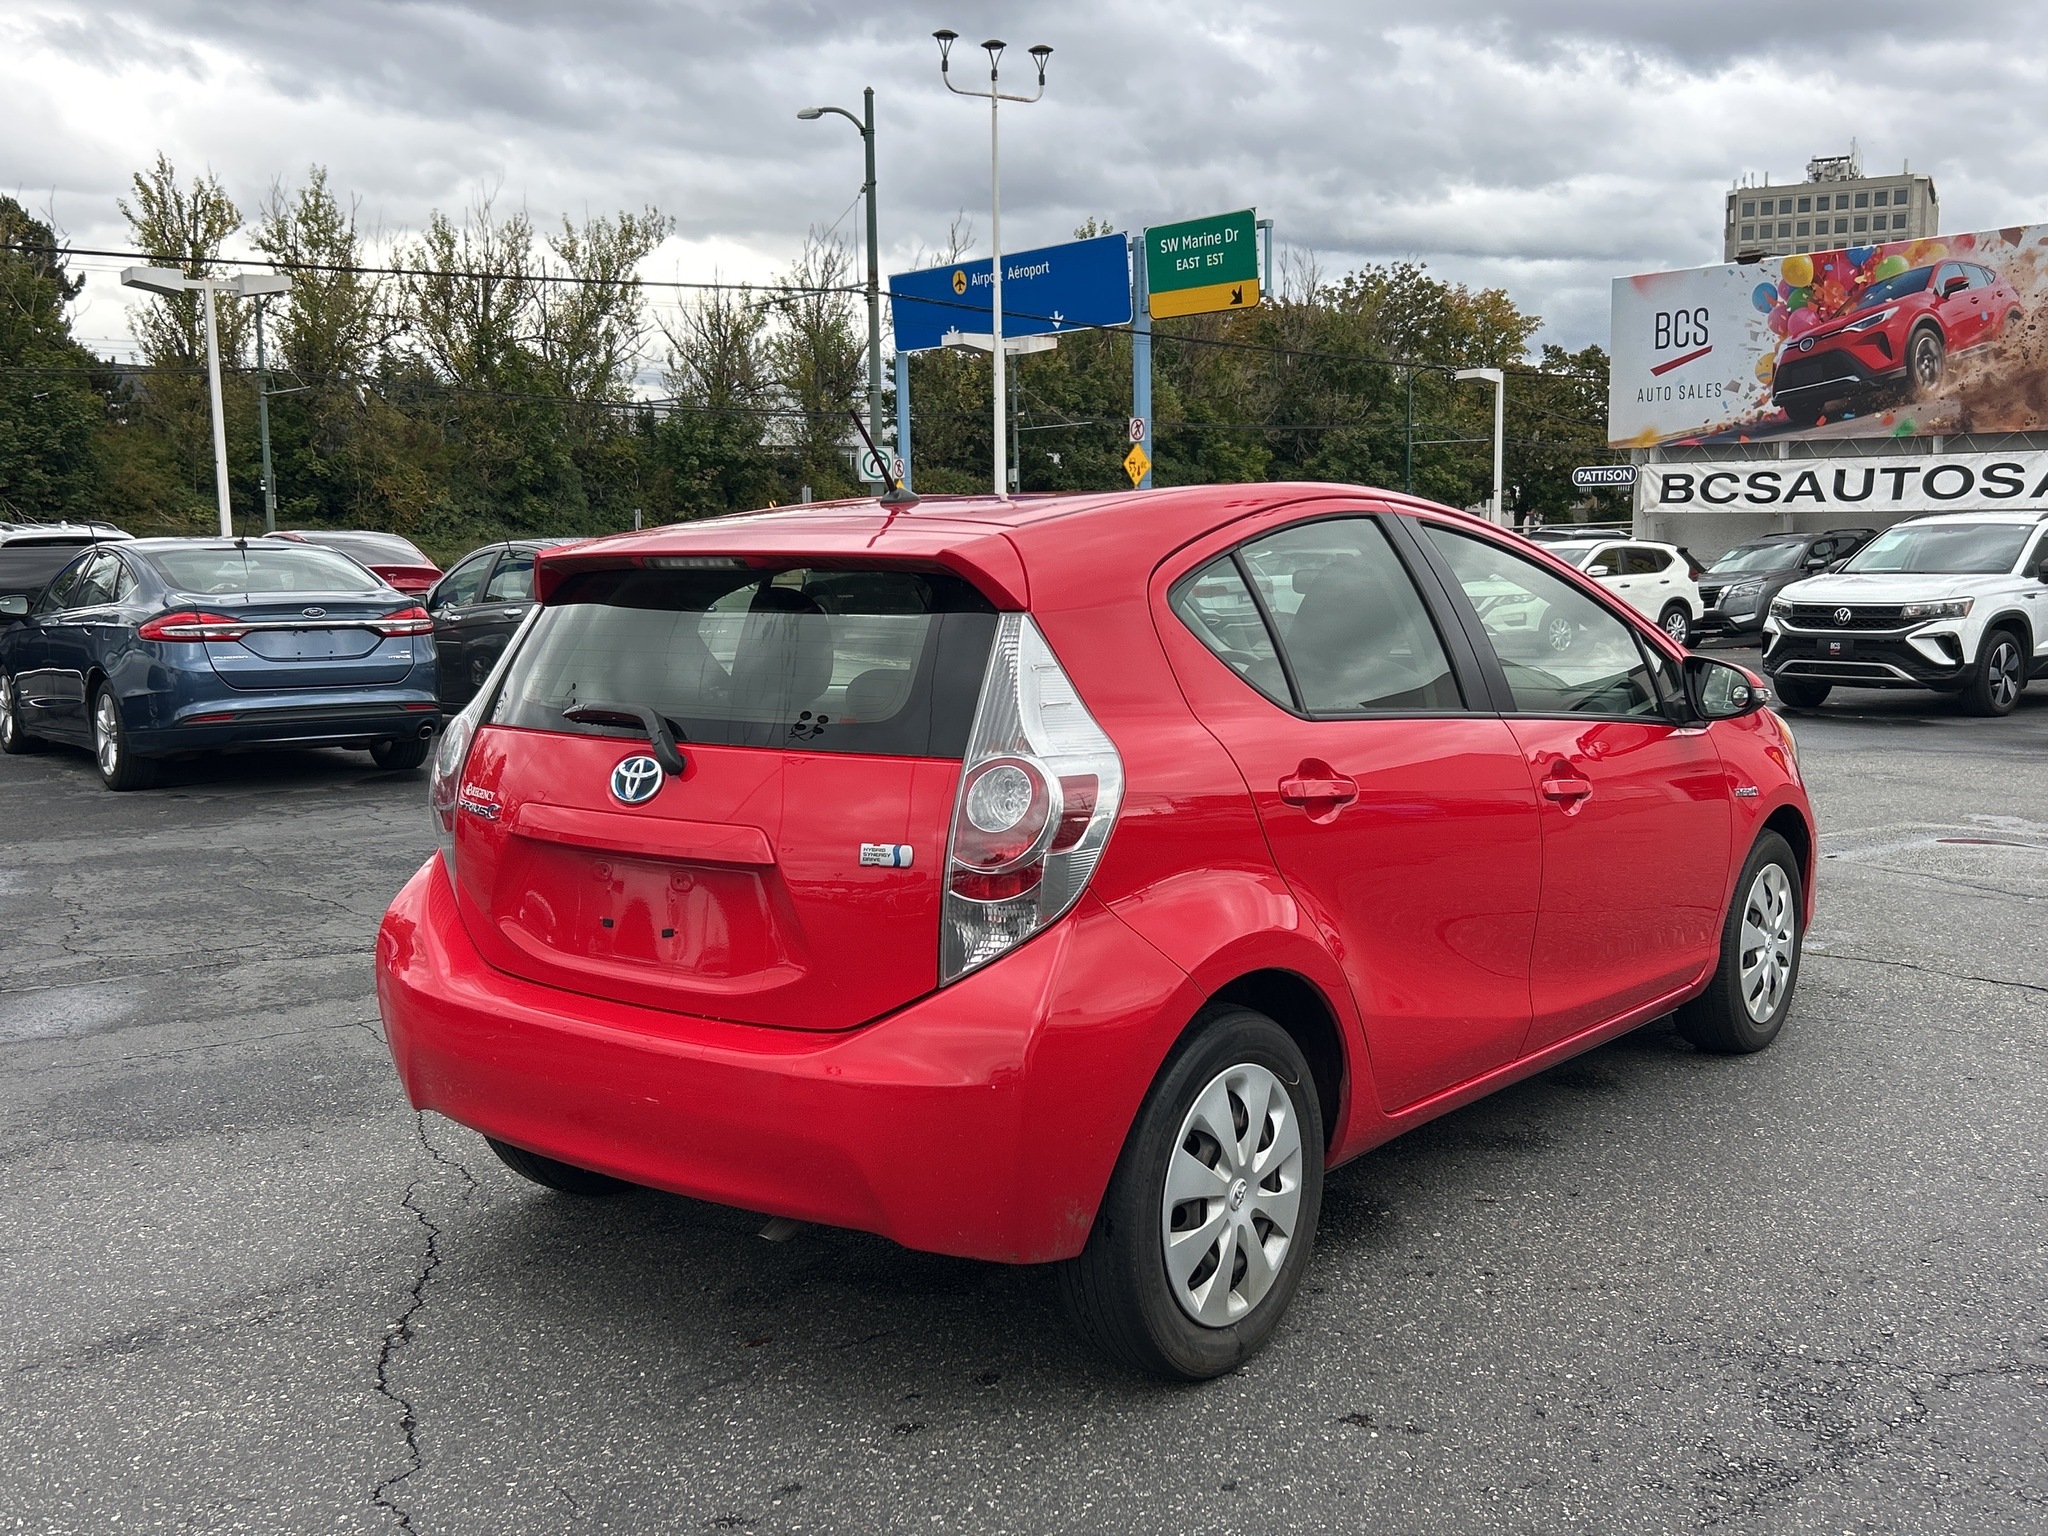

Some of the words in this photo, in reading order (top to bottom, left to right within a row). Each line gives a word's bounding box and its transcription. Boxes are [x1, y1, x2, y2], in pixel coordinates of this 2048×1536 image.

[1160, 237, 1179, 254] SW
[1182, 232, 1222, 250] Marine
[1225, 228, 1239, 243] Dr
[1176, 256, 1200, 271] EAST
[1206, 252, 1224, 266] EST
[971, 271, 1004, 288] Airpot
[1007, 261, 1050, 280] Aéroport
[1655, 307, 1709, 350] BCS
[1637, 386, 1672, 403] AUTO
[1679, 382, 1722, 400] SALES
[1577, 469, 1633, 482] PATTISON
